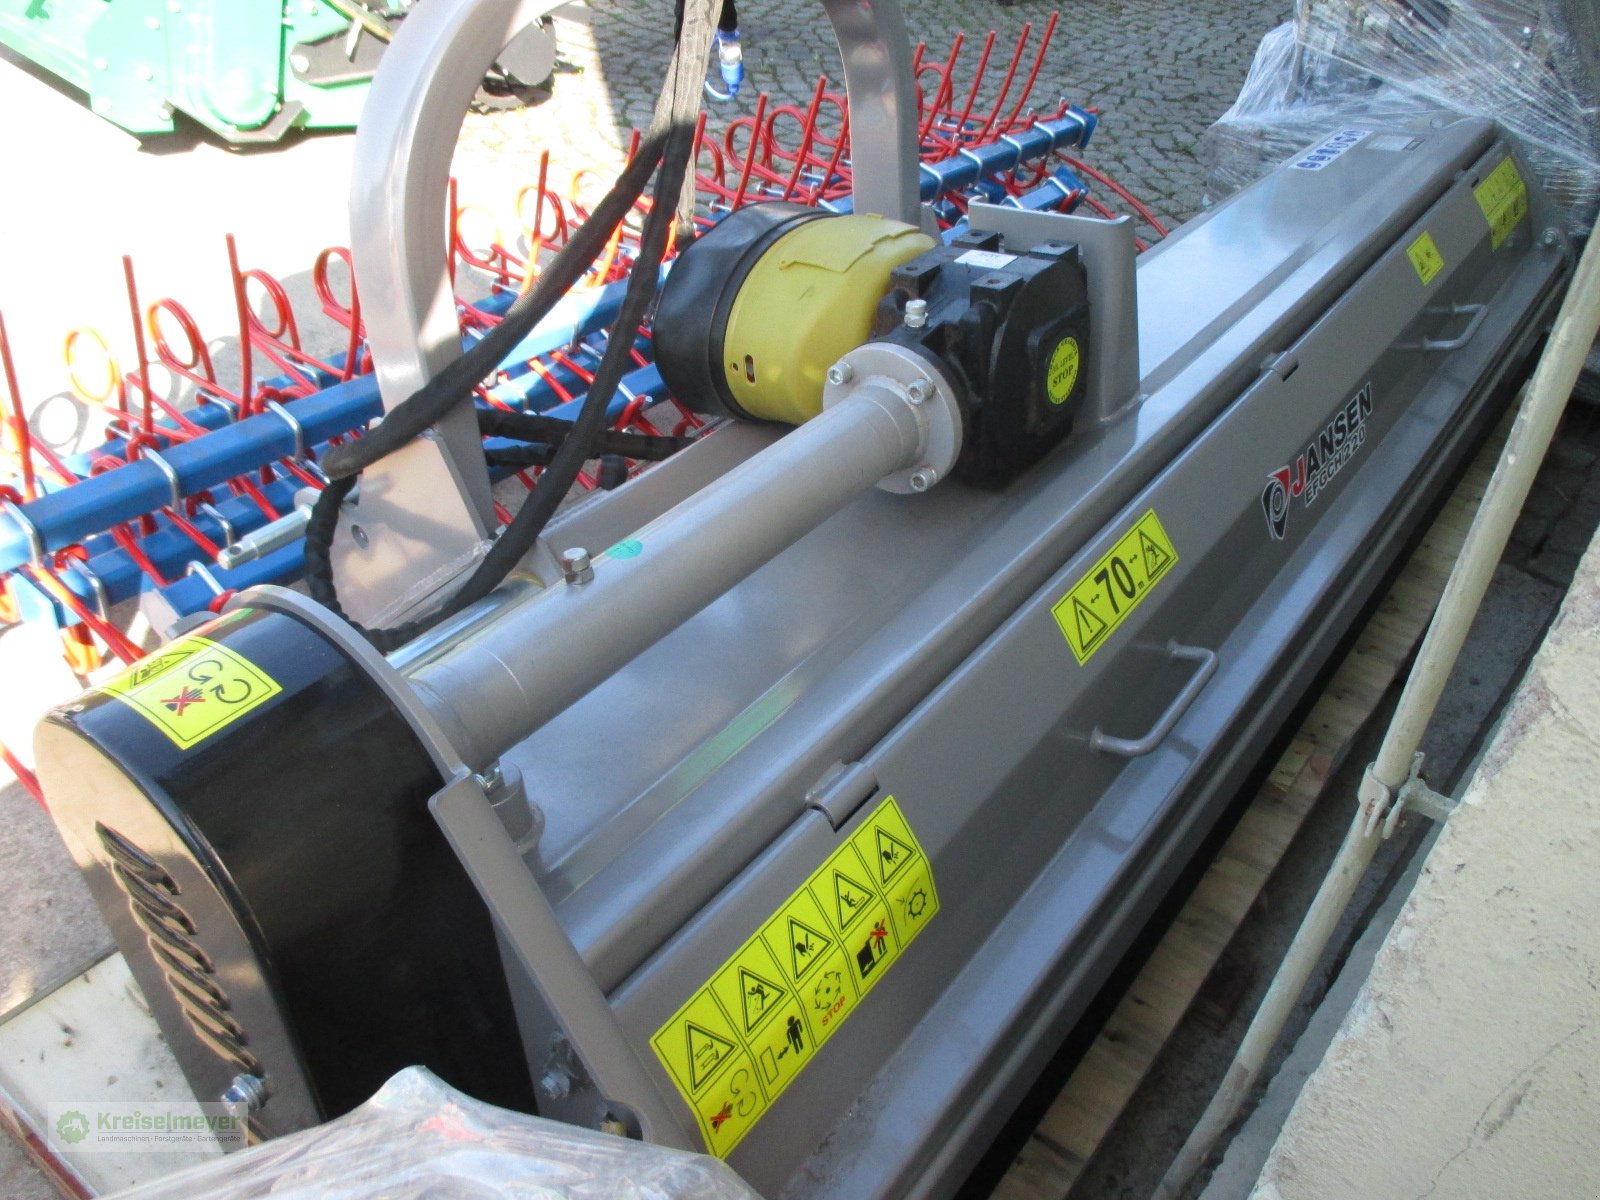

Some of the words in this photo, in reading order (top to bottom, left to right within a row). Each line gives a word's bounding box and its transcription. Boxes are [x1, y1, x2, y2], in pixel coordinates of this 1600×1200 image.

[1052, 364, 1074, 388] STOP
[1292, 382, 1373, 497] JANSEN
[1094, 556, 1136, 616] 70
[822, 995, 846, 1027] STOP
